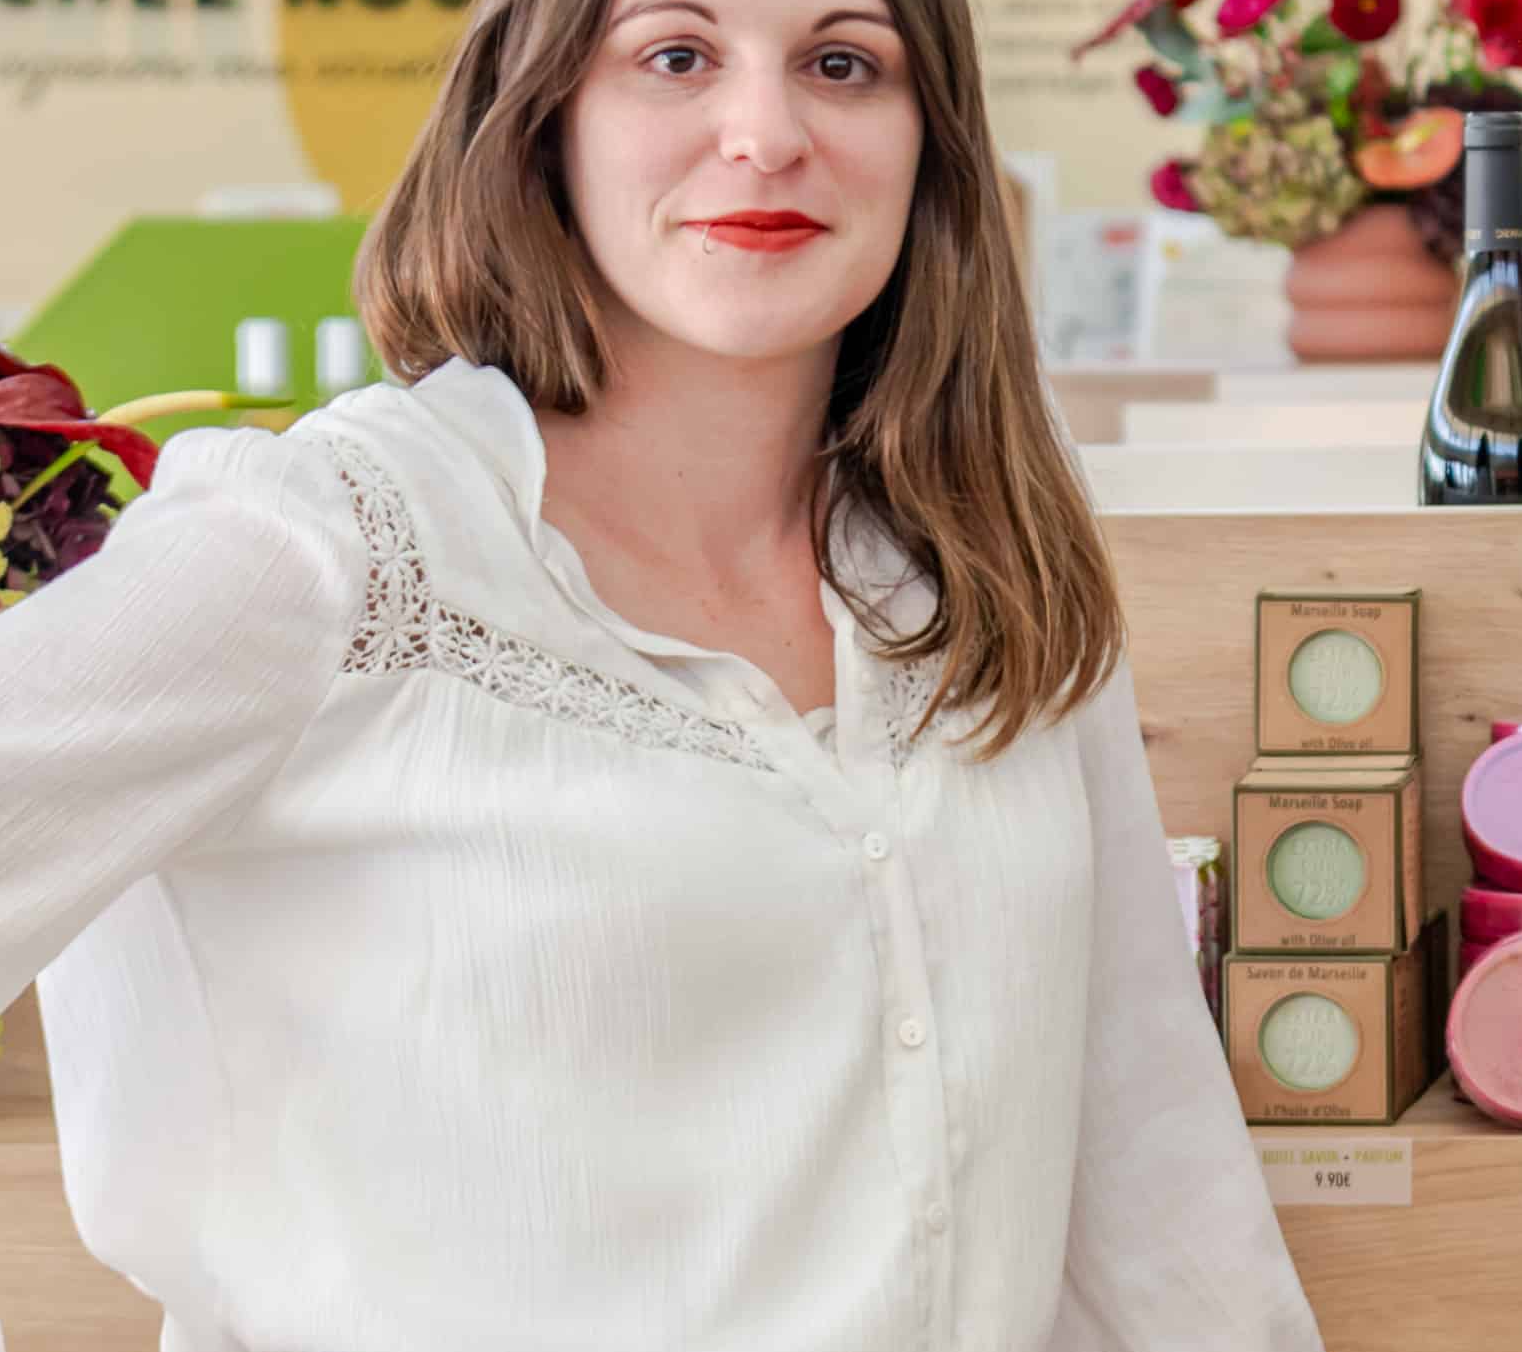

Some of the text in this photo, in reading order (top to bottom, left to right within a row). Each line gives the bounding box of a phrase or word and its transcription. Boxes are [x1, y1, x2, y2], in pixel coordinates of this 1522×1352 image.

[1290, 603, 1382, 620] Marseille Soap
[1269, 795, 1363, 813] Marseille Soap
[1280, 934, 1306, 946] with
[1309, 934, 1338, 946] Olive
[1246, 966, 1367, 981] Savon de Marseille
[1314, 1171, 1351, 1188] 9.90€
